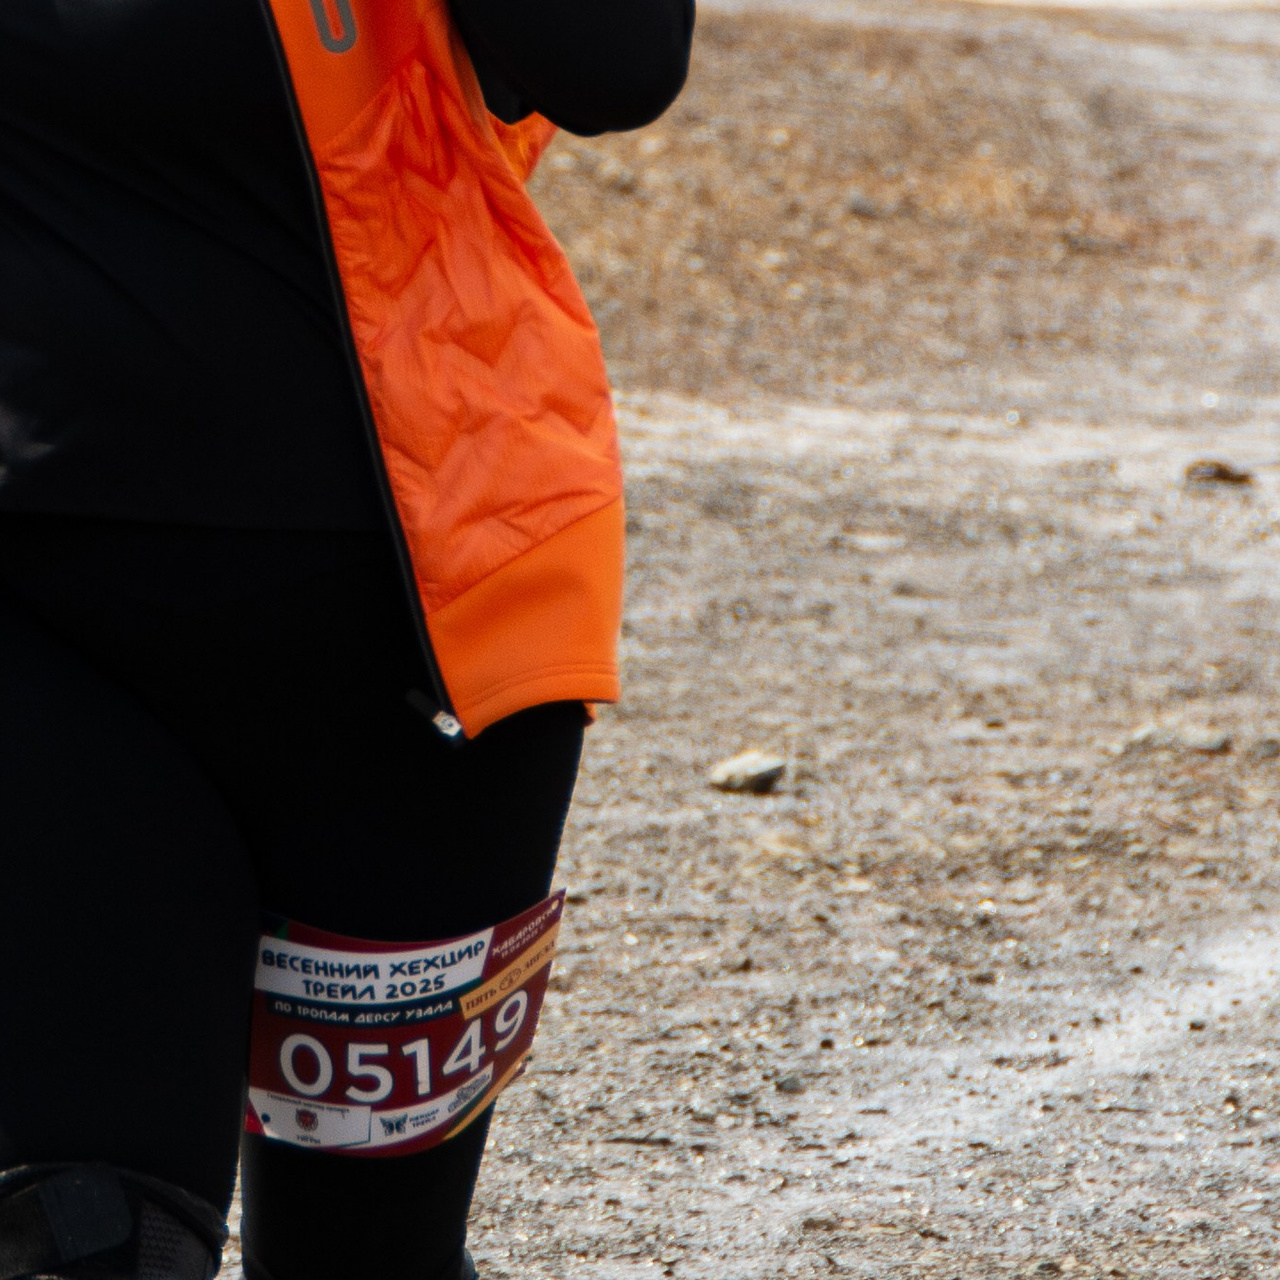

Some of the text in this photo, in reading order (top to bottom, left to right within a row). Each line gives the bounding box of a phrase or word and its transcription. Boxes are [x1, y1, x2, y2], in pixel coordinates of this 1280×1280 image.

[262, 948, 380, 979] ВЕСЕННИЙ
[389, 939, 485, 978] ХЕХЦИР
[302, 973, 446, 1000] ТРЕЙЛ 2025
[275, 1000, 453, 1023] ПО ТРОПАМ ДЕРСУ УЗАЛА
[279, 988, 529, 1104] 05149
